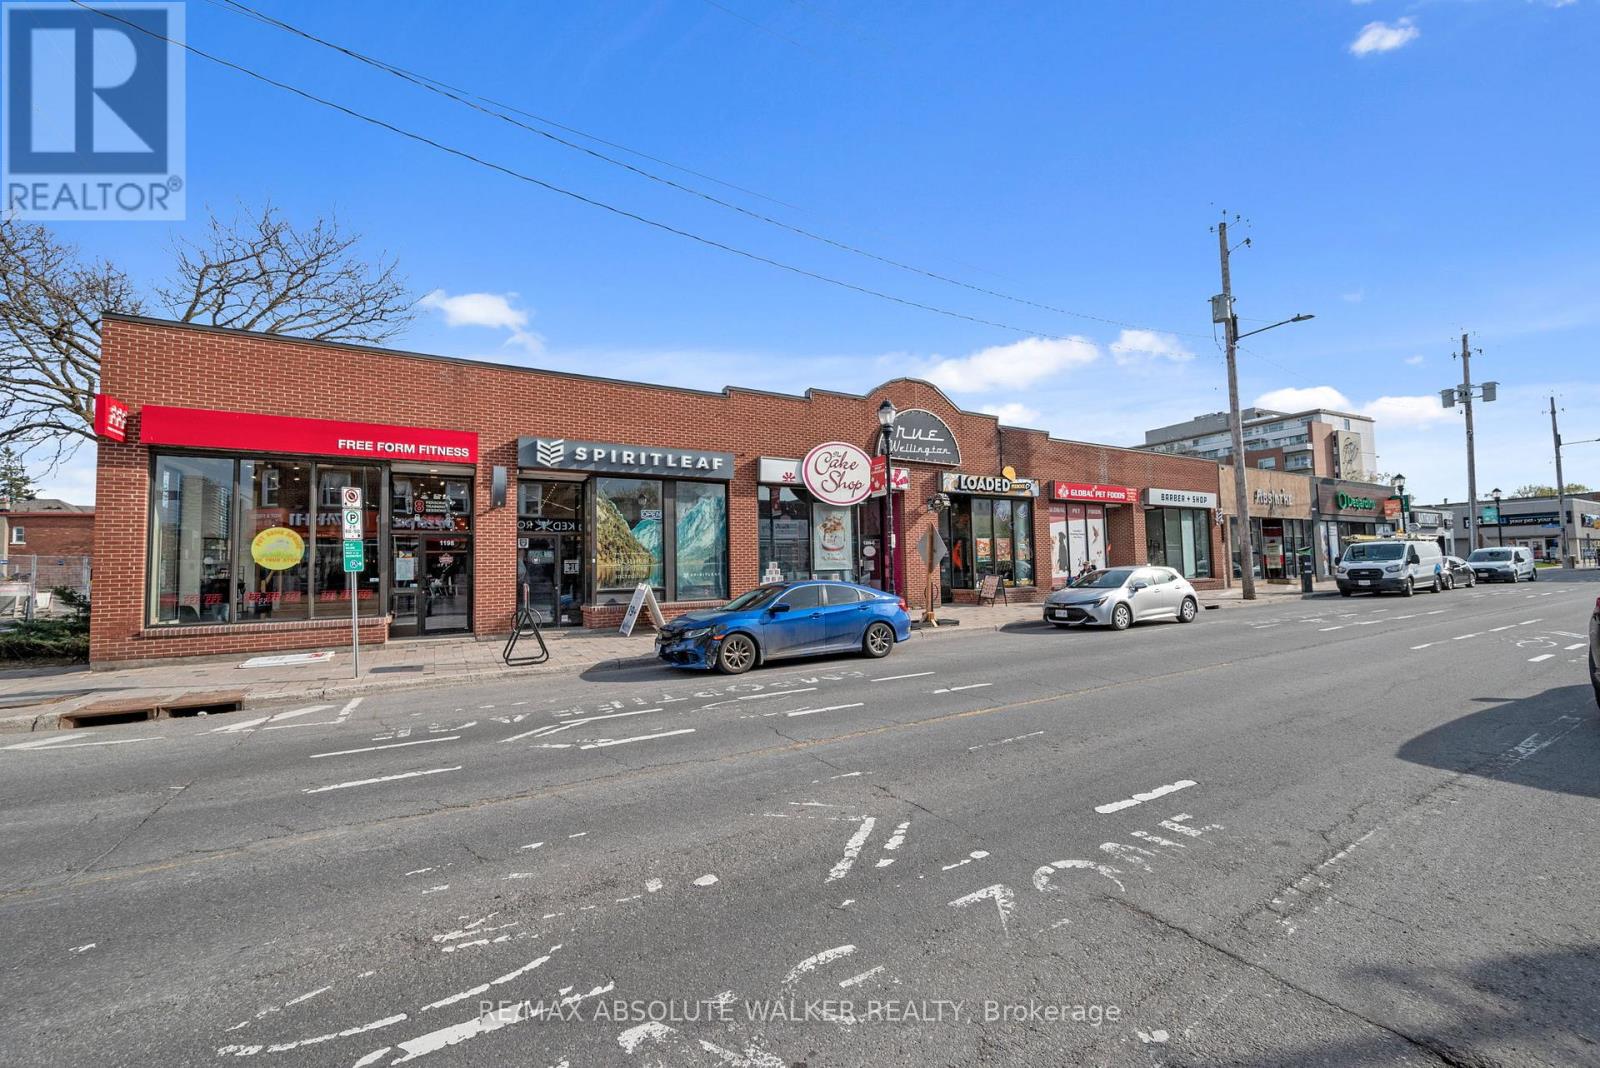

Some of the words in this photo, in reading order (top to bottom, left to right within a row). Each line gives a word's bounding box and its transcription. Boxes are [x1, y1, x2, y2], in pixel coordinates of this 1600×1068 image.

[338, 439, 373, 451] FREE
[377, 442, 415, 453] FORM
[419, 445, 470, 457] FITNESS
[889, 440, 951, 456] Wellington
[574, 446, 724, 471] SPIRITLEAF
[815, 451, 859, 475] Cake
[821, 470, 865, 497] Shop
[960, 475, 1011, 492] LOADED
[1070, 489, 1093, 498] GLOBAL
[1095, 490, 1106, 498] PET
[1107, 491, 1126, 499] FOODS
[1160, 493, 1185, 502] BARBER
[1192, 495, 1208, 504] SHOP
